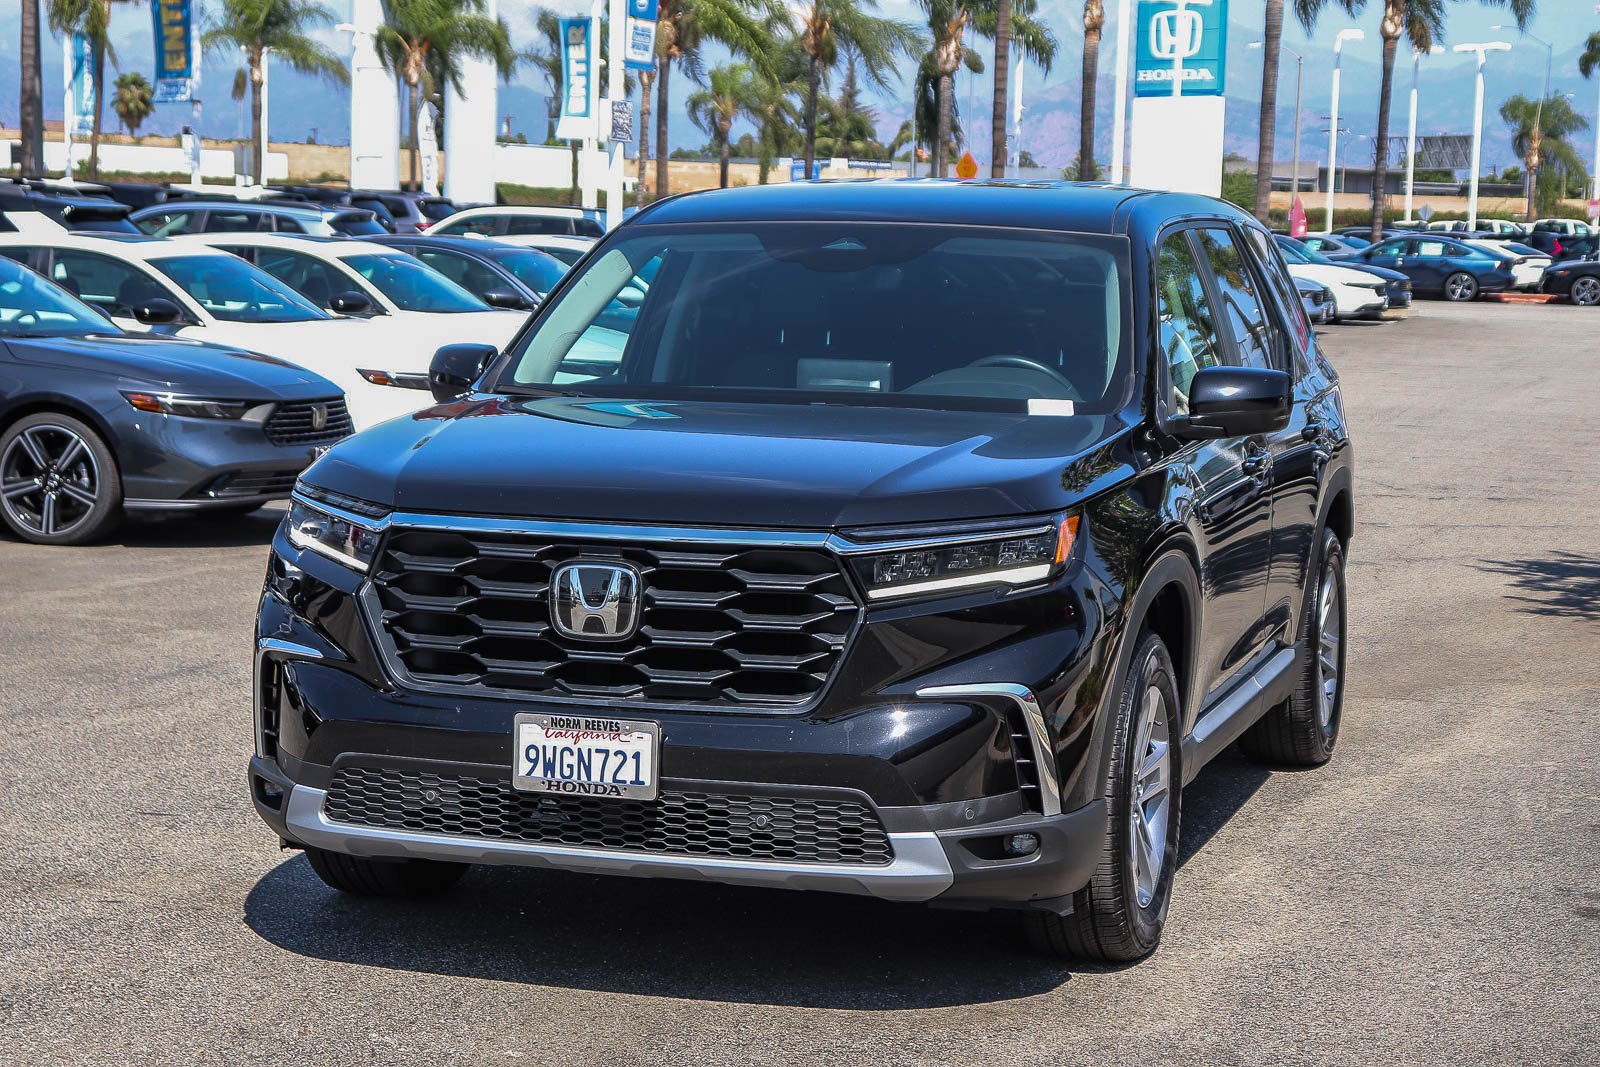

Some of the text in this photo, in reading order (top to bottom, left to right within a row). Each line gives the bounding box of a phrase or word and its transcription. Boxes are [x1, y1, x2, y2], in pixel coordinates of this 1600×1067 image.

[161, 0, 186, 71] ENT
[550, 716, 620, 733] NORM REEVES
[544, 727, 631, 745] California
[524, 743, 646, 786] 9WGN721
[545, 780, 624, 797] HONDA
